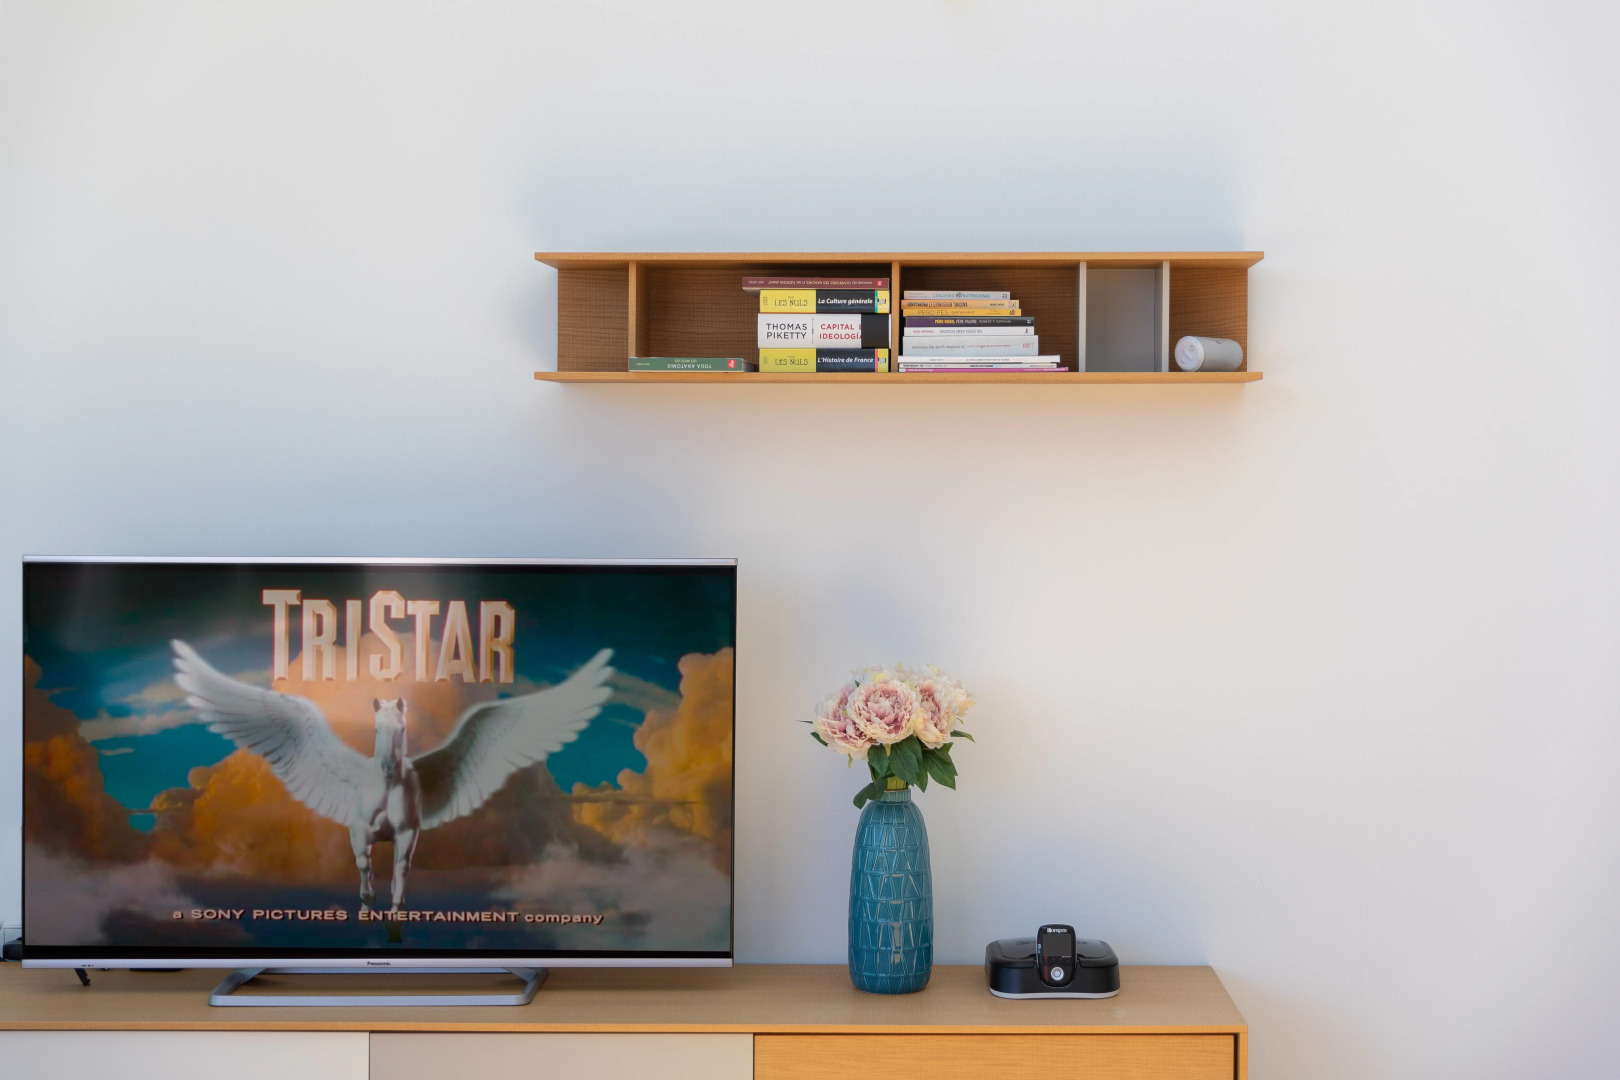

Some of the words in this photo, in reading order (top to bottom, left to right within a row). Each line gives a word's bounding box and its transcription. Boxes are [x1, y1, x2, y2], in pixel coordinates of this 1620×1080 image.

[774, 299, 787, 307] LES
[789, 299, 808, 307] NULS
[847, 298, 873, 306] générale
[766, 323, 808, 331] THOMAS
[766, 331, 807, 340] PIKETTY
[173, 911, 183, 919] a
[191, 909, 244, 920] SONY
[252, 909, 348, 920] PICTURES
[358, 910, 519, 921] ENTERTAINMENT
[524, 912, 604, 925] company
